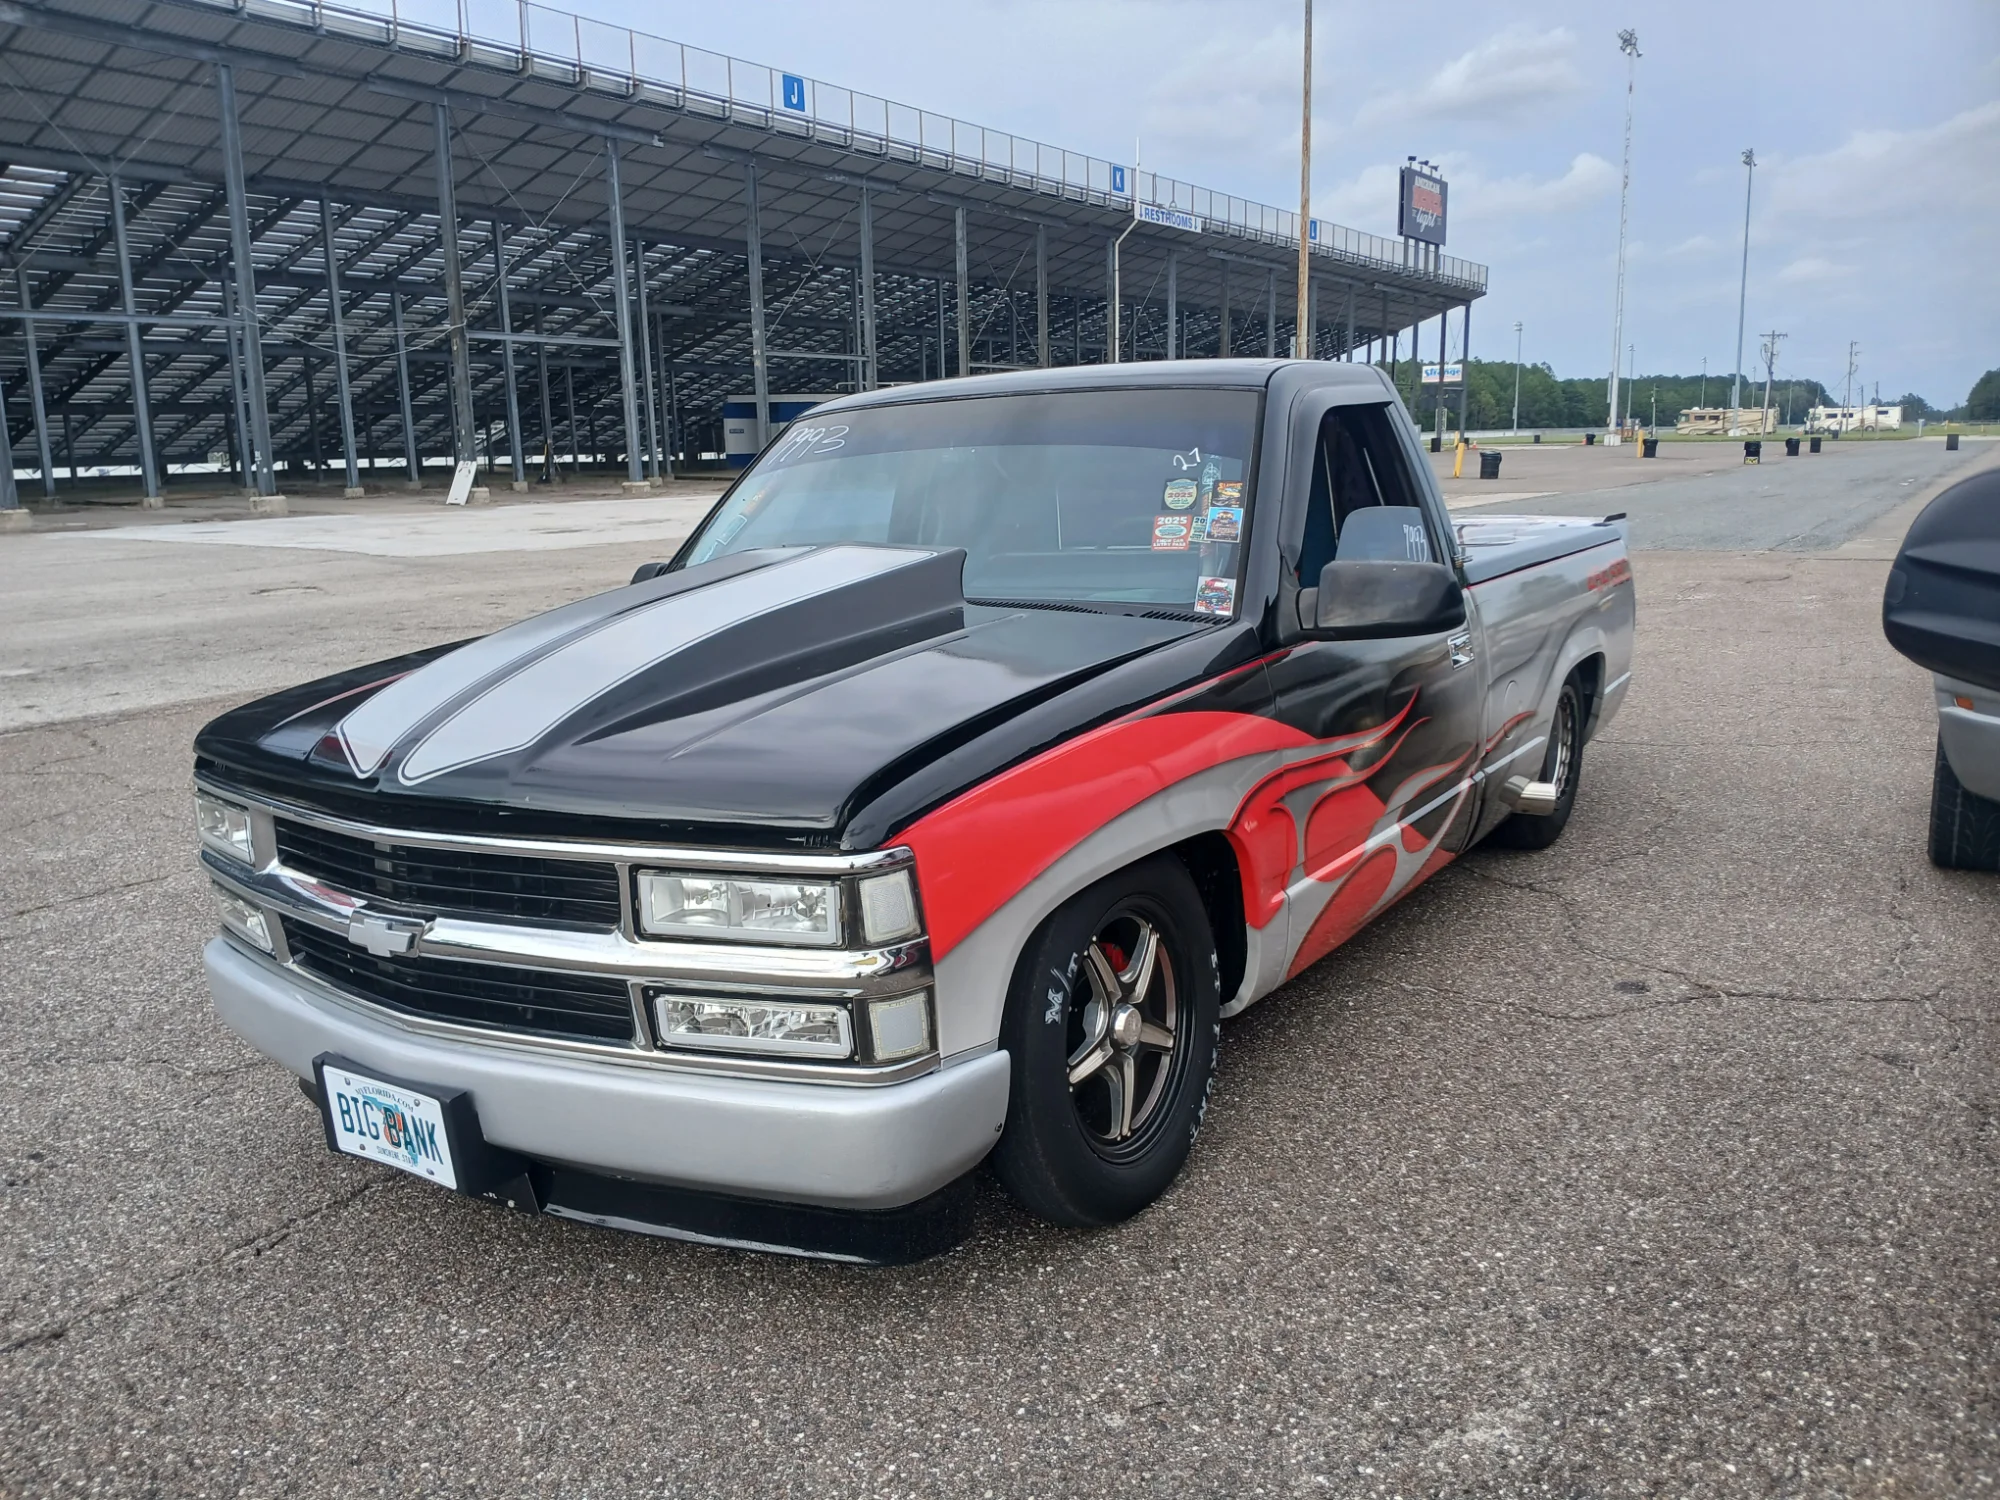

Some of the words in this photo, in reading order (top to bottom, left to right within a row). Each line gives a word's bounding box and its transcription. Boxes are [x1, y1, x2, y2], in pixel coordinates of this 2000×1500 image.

[790, 81, 798, 105] J
[1115, 170, 1122, 189] K
[1144, 207, 1193, 229] RESTROOMS
[1157, 516, 1188, 525] 2025
[336, 1092, 380, 1140] BIG
[383, 1106, 444, 1165] BANK
